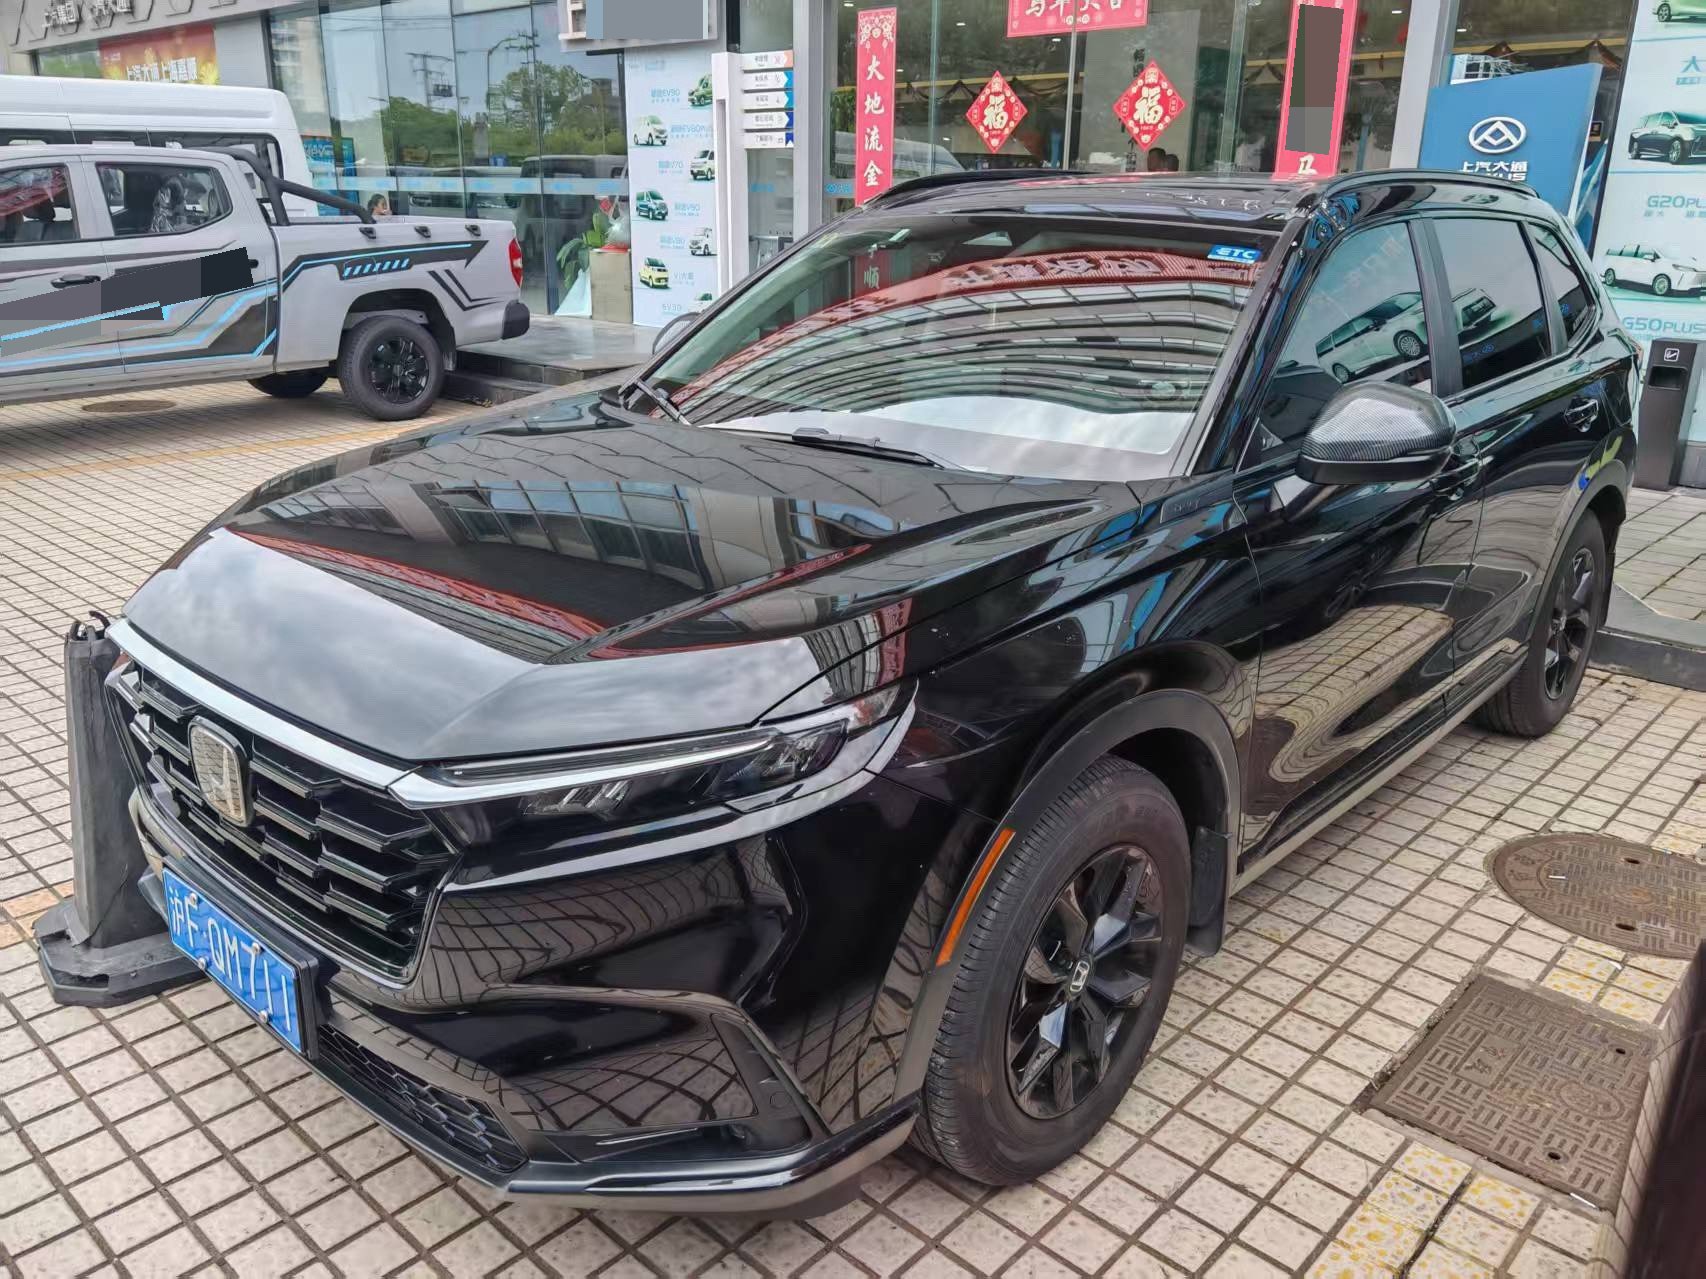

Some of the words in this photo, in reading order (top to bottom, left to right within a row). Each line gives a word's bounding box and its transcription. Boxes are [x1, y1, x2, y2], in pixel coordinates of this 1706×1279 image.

[983, 94, 1009, 129] 福
[1133, 86, 1164, 124] 福
[863, 54, 886, 187] 大地流金
[1460, 160, 1528, 173] 上汽大通
[1215, 247, 1257, 259] ETC
[1622, 316, 1706, 335] G50PLUS
